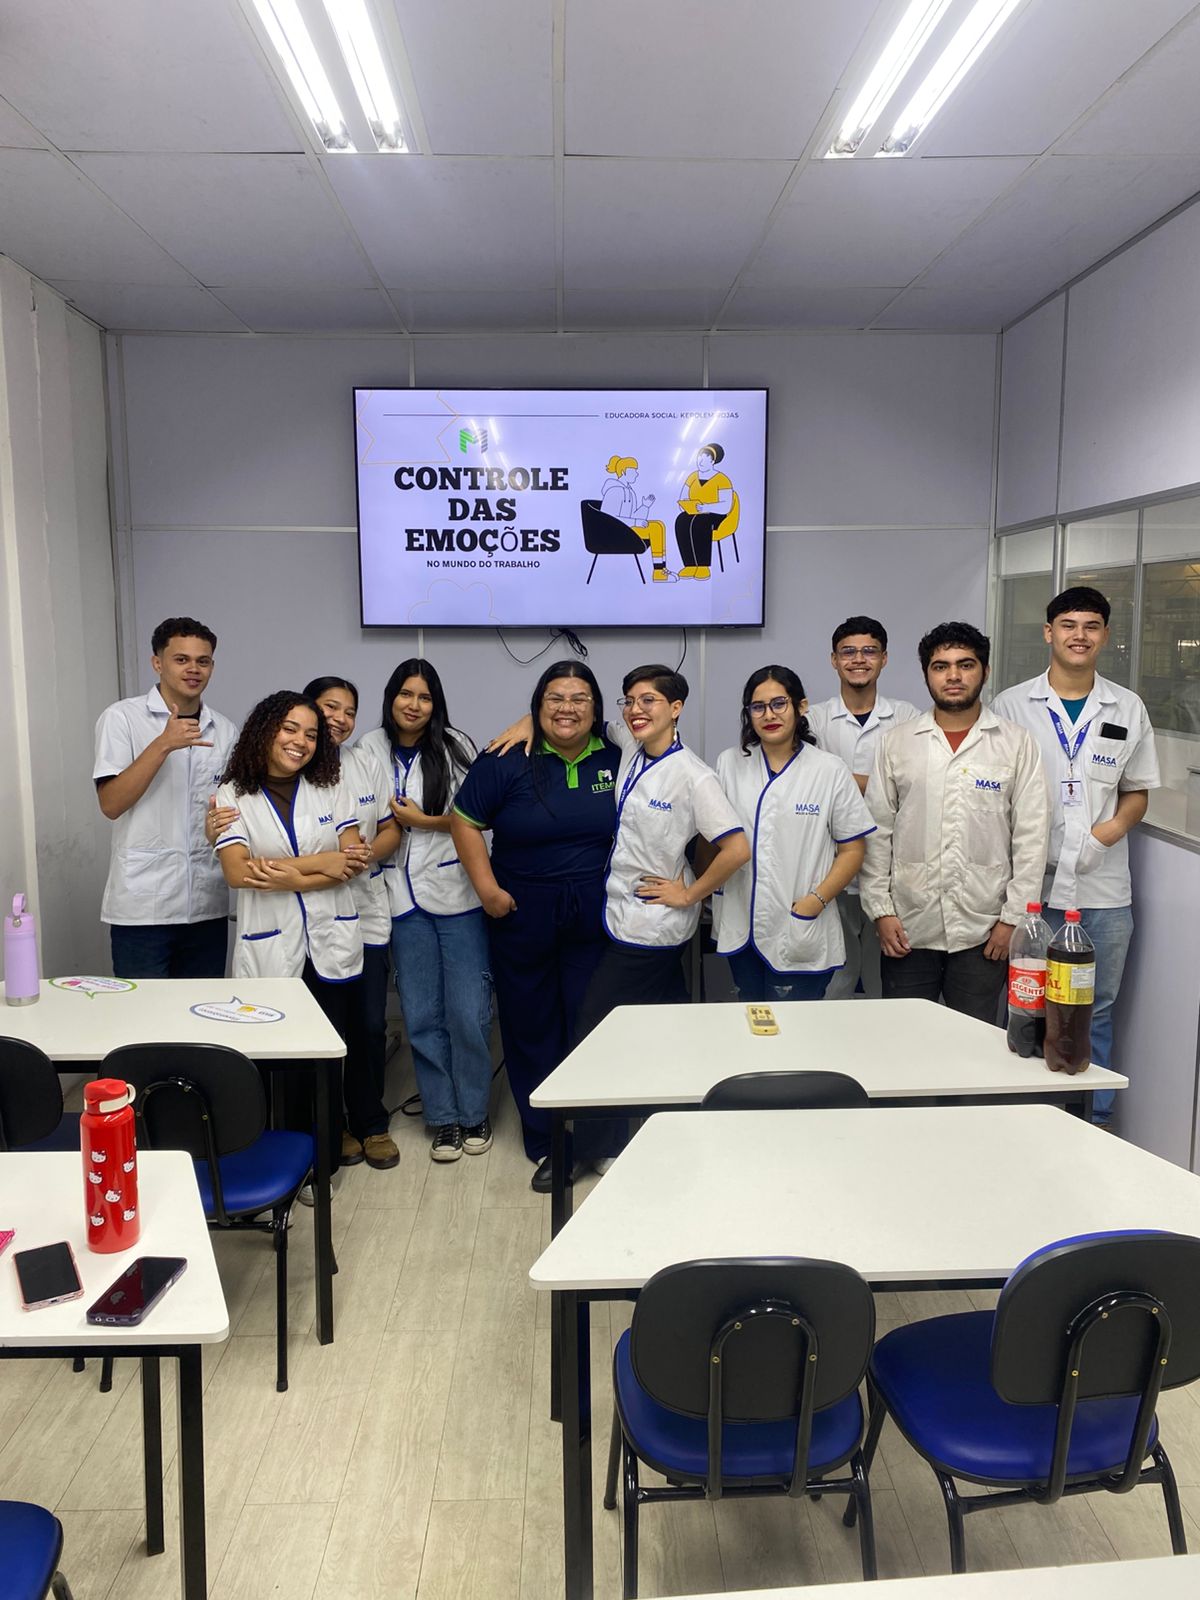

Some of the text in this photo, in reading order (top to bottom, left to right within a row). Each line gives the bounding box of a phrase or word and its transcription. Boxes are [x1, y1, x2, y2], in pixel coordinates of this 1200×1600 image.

[604, 411, 649, 419] EDUCADORA
[394, 466, 569, 491] CONTROLE
[448, 498, 517, 521] DAS
[405, 526, 561, 558] EMOÇÕES
[427, 560, 540, 568] NO MUNDO DO TRABALHO
[1092, 754, 1117, 765] MASA
[975, 779, 1001, 790] MASA
[648, 799, 672, 810] MASA
[795, 803, 820, 812] MASA
[318, 813, 334, 824] MAS
